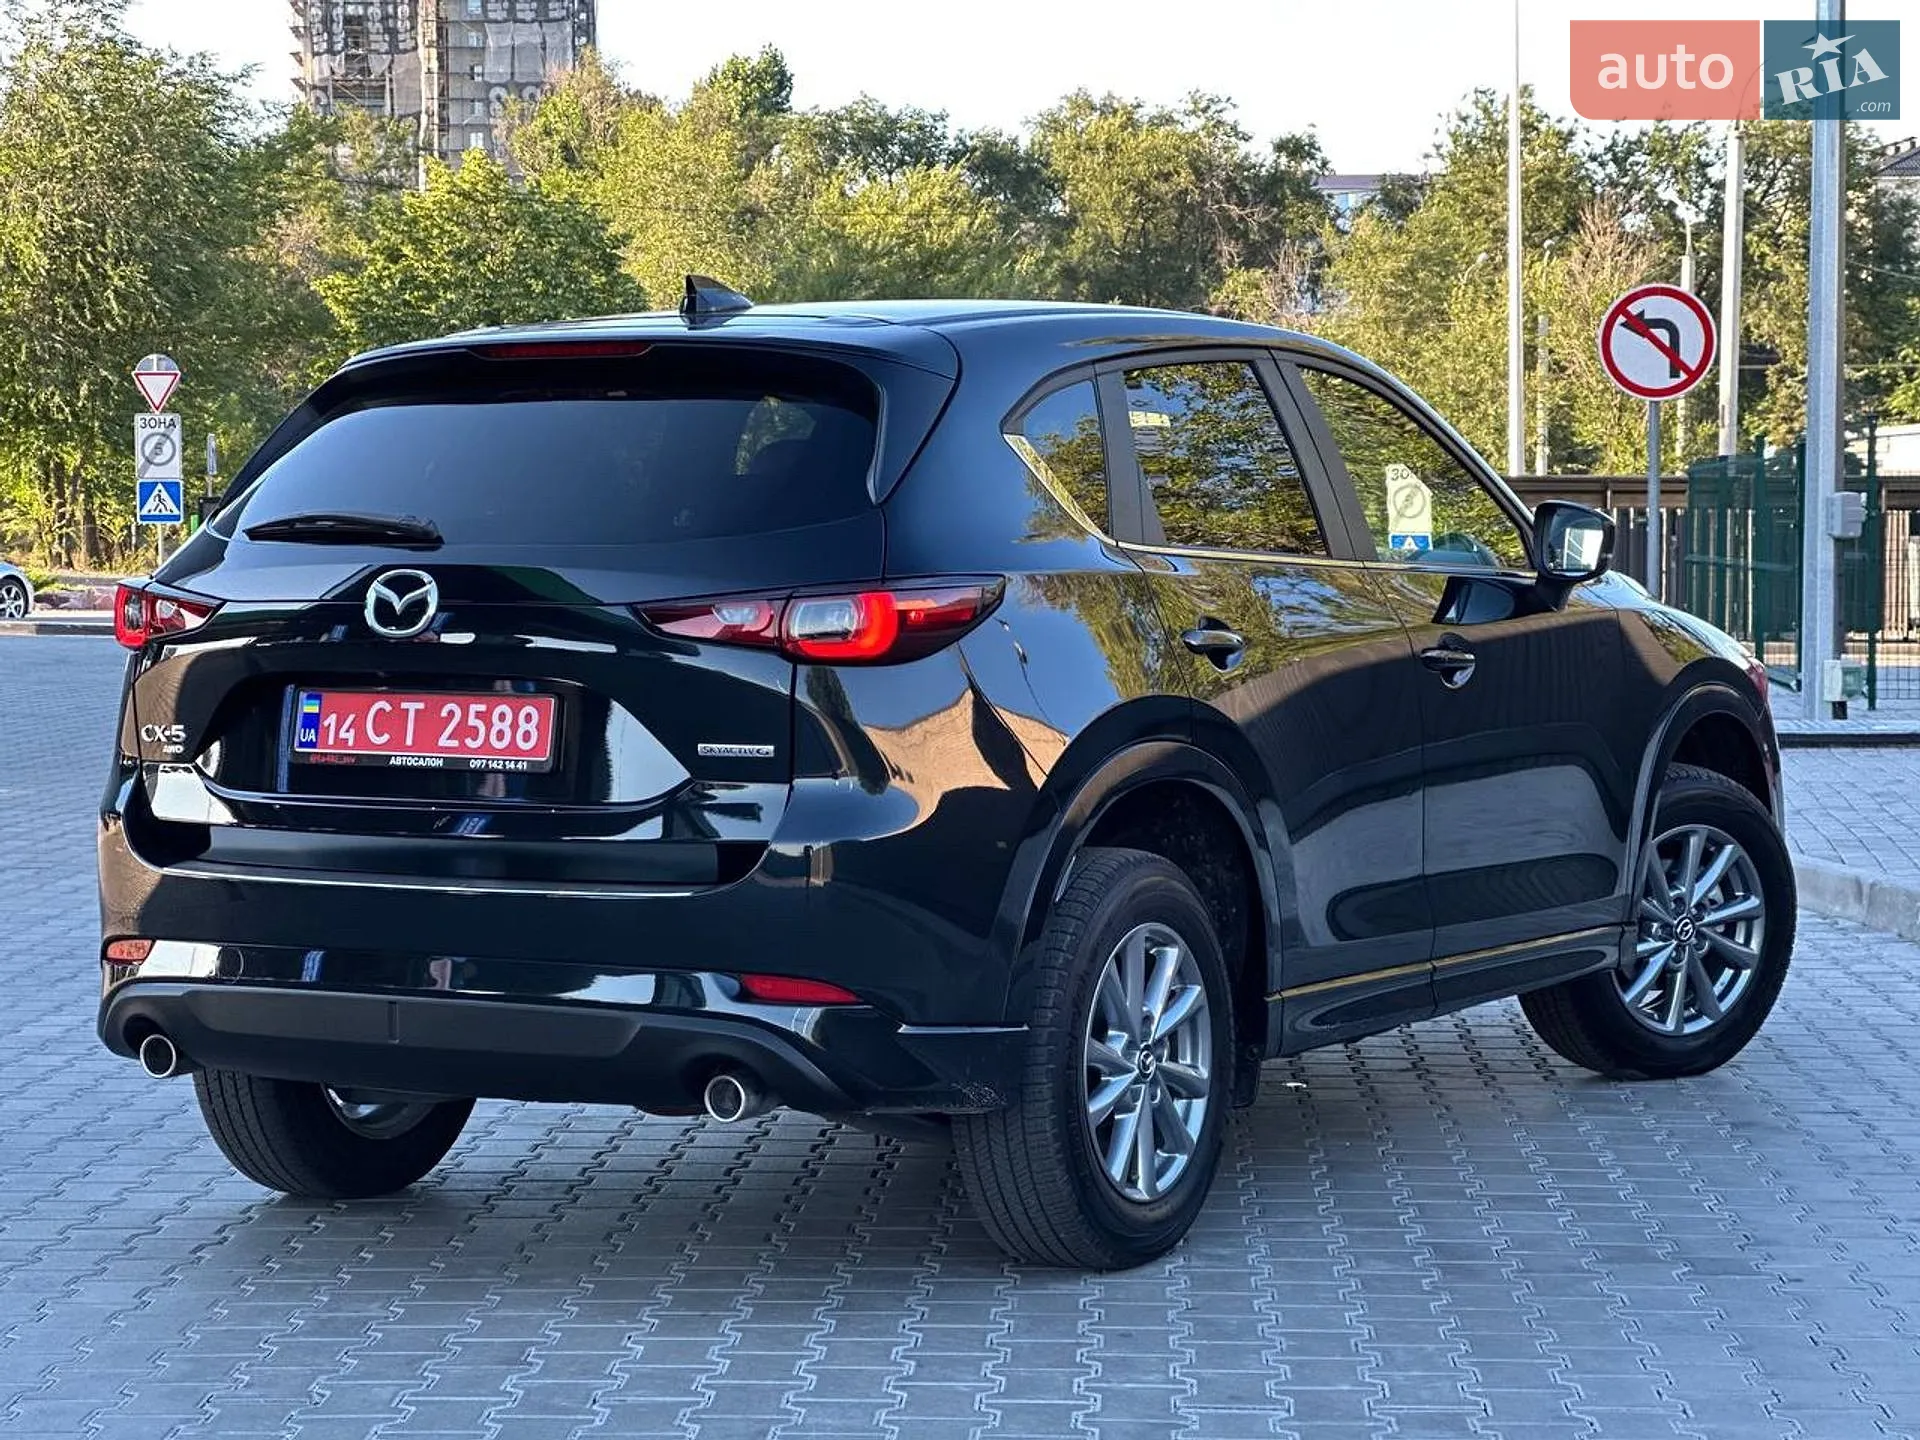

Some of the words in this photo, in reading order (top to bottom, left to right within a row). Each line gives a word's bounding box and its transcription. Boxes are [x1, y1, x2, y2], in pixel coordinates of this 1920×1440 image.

[139, 417, 177, 429] ЗОНА
[323, 713, 355, 747] 14
[365, 700, 425, 746] CT
[438, 703, 539, 751] 2588
[141, 724, 187, 743] CX-5
[300, 728, 316, 743] UA
[389, 756, 443, 767] АВТОСАЛОН
[469, 759, 487, 769] 097
